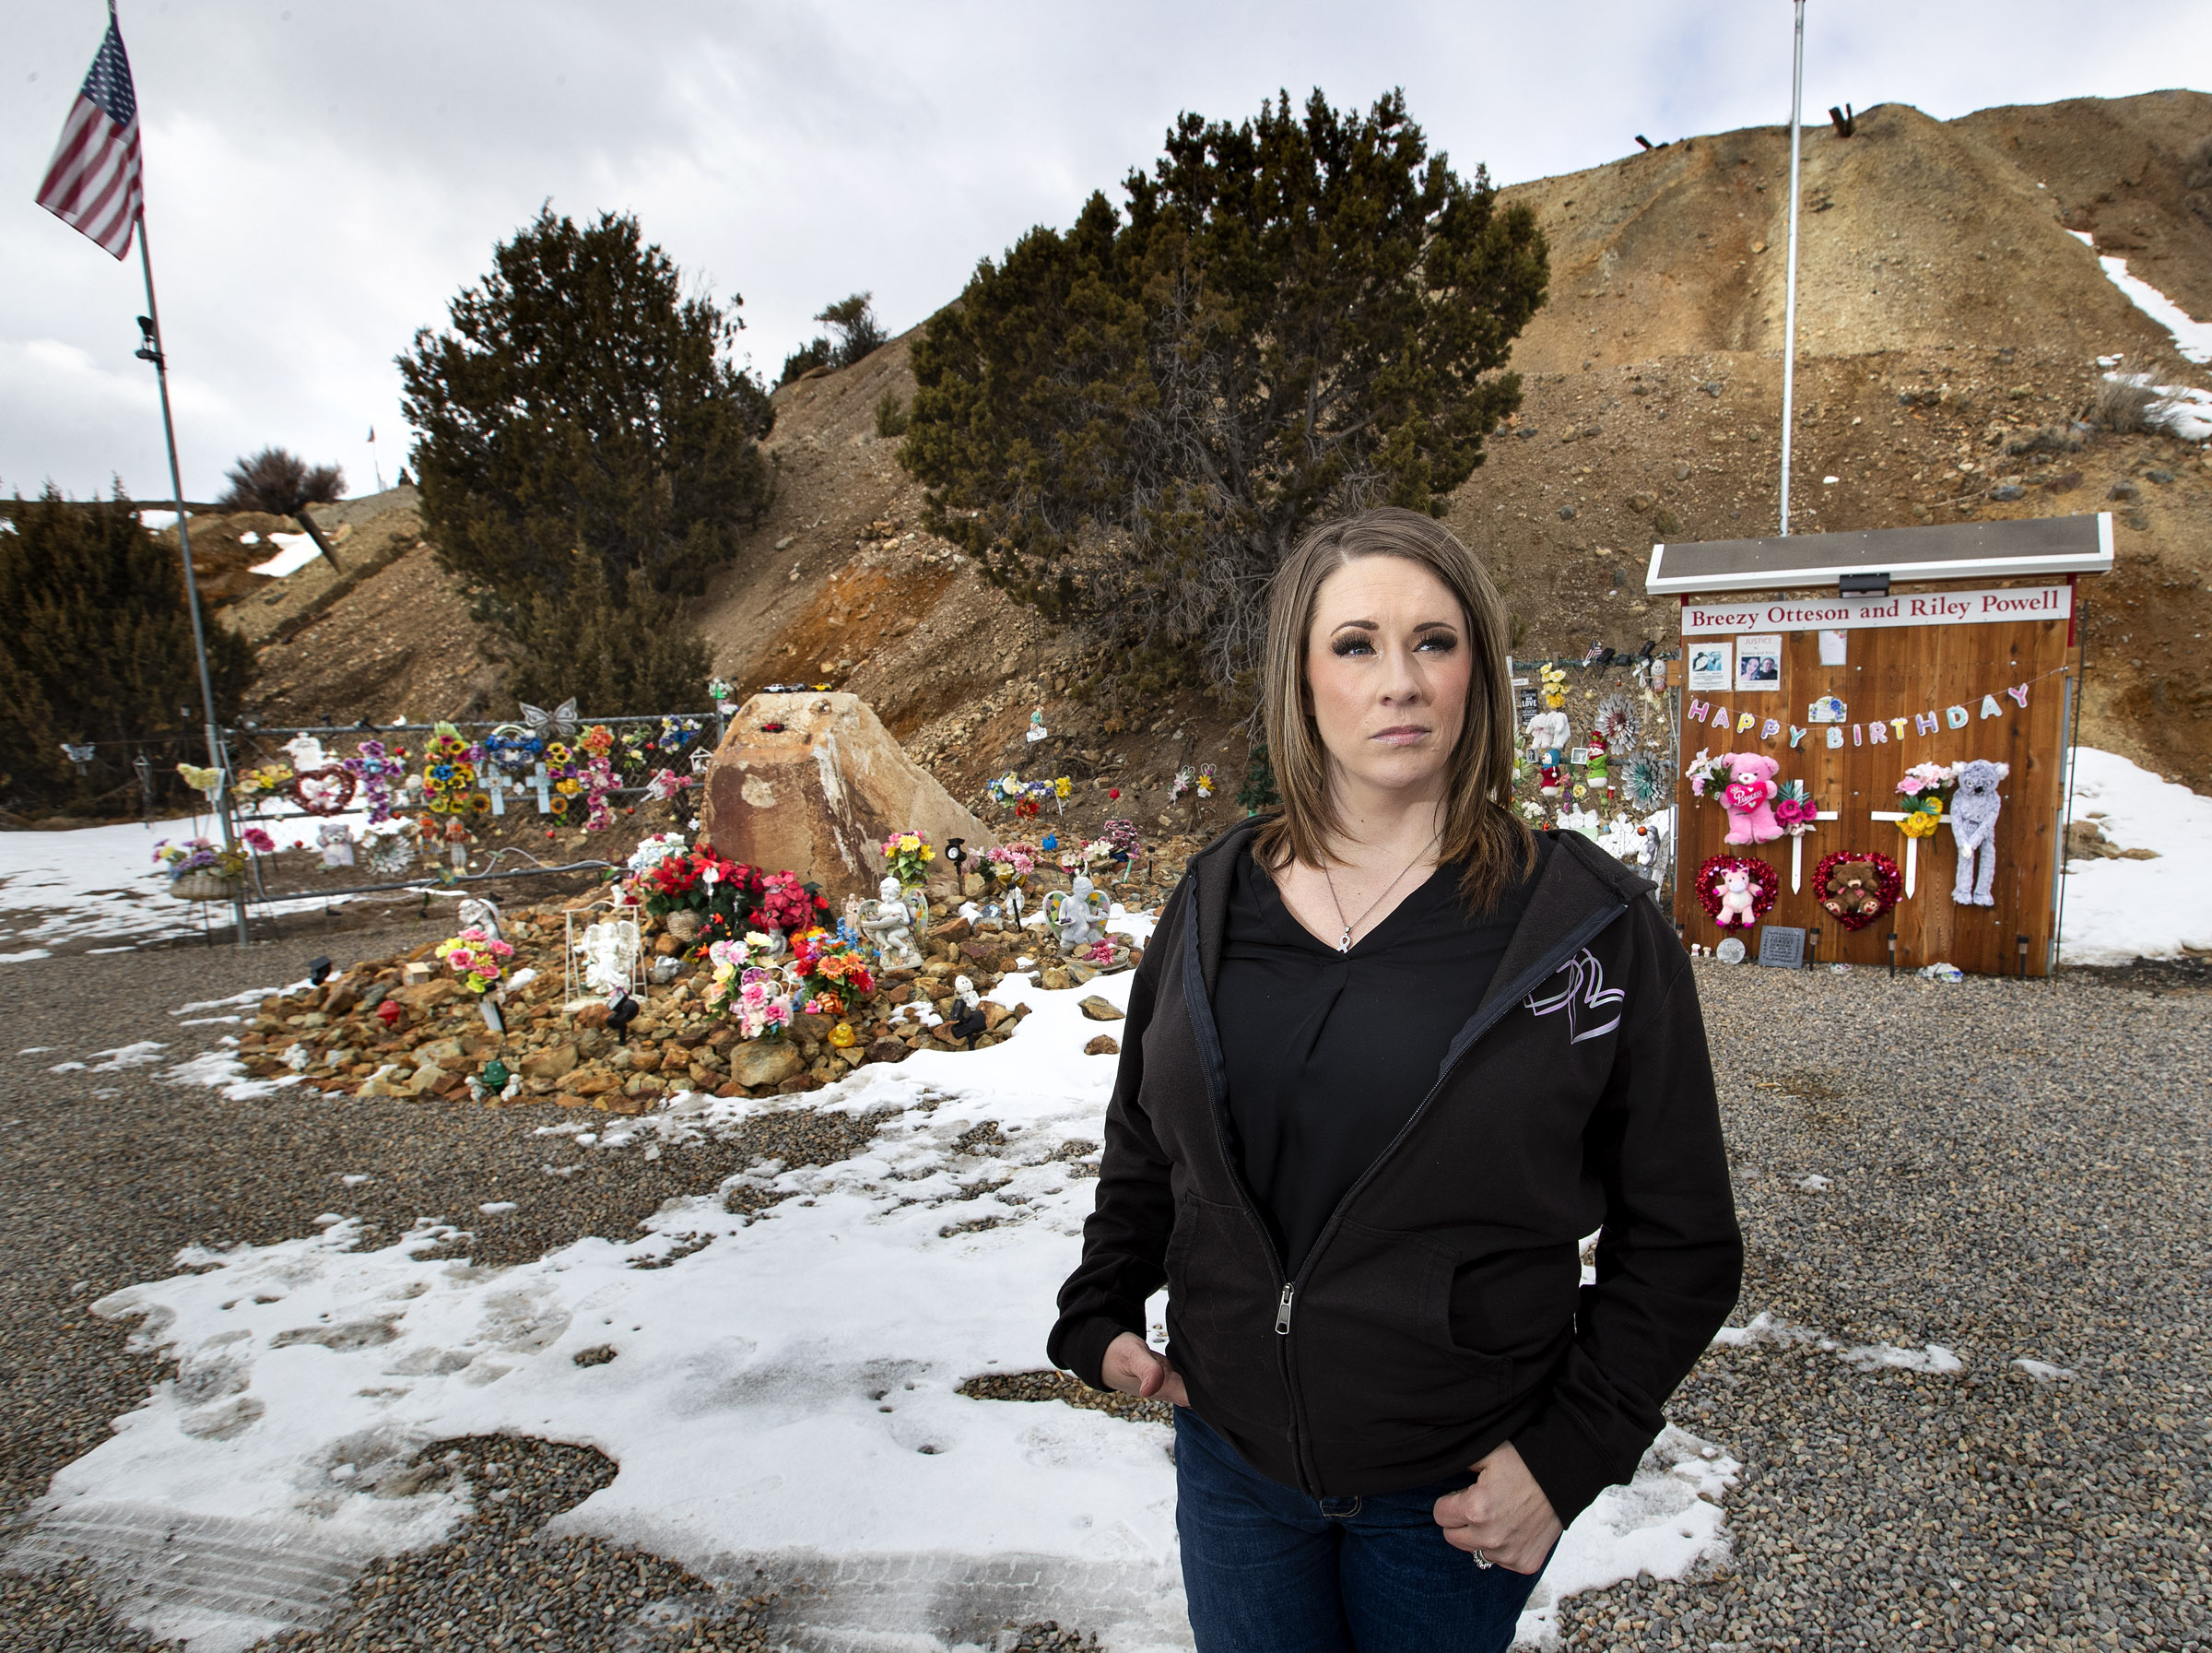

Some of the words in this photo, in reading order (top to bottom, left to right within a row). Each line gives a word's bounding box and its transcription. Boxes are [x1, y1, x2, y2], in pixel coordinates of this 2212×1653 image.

[1691, 610, 1759, 630] Breezy
[1768, 606, 1850, 624] Otteson
[1860, 599, 1900, 620] and
[1910, 596, 1971, 620] Riley
[1982, 590, 2059, 613] Powell
[1688, 699, 1806, 749] HAPPY
[1827, 683, 2028, 750] BIRTHDAY
[1734, 790, 1763, 806] Princess
